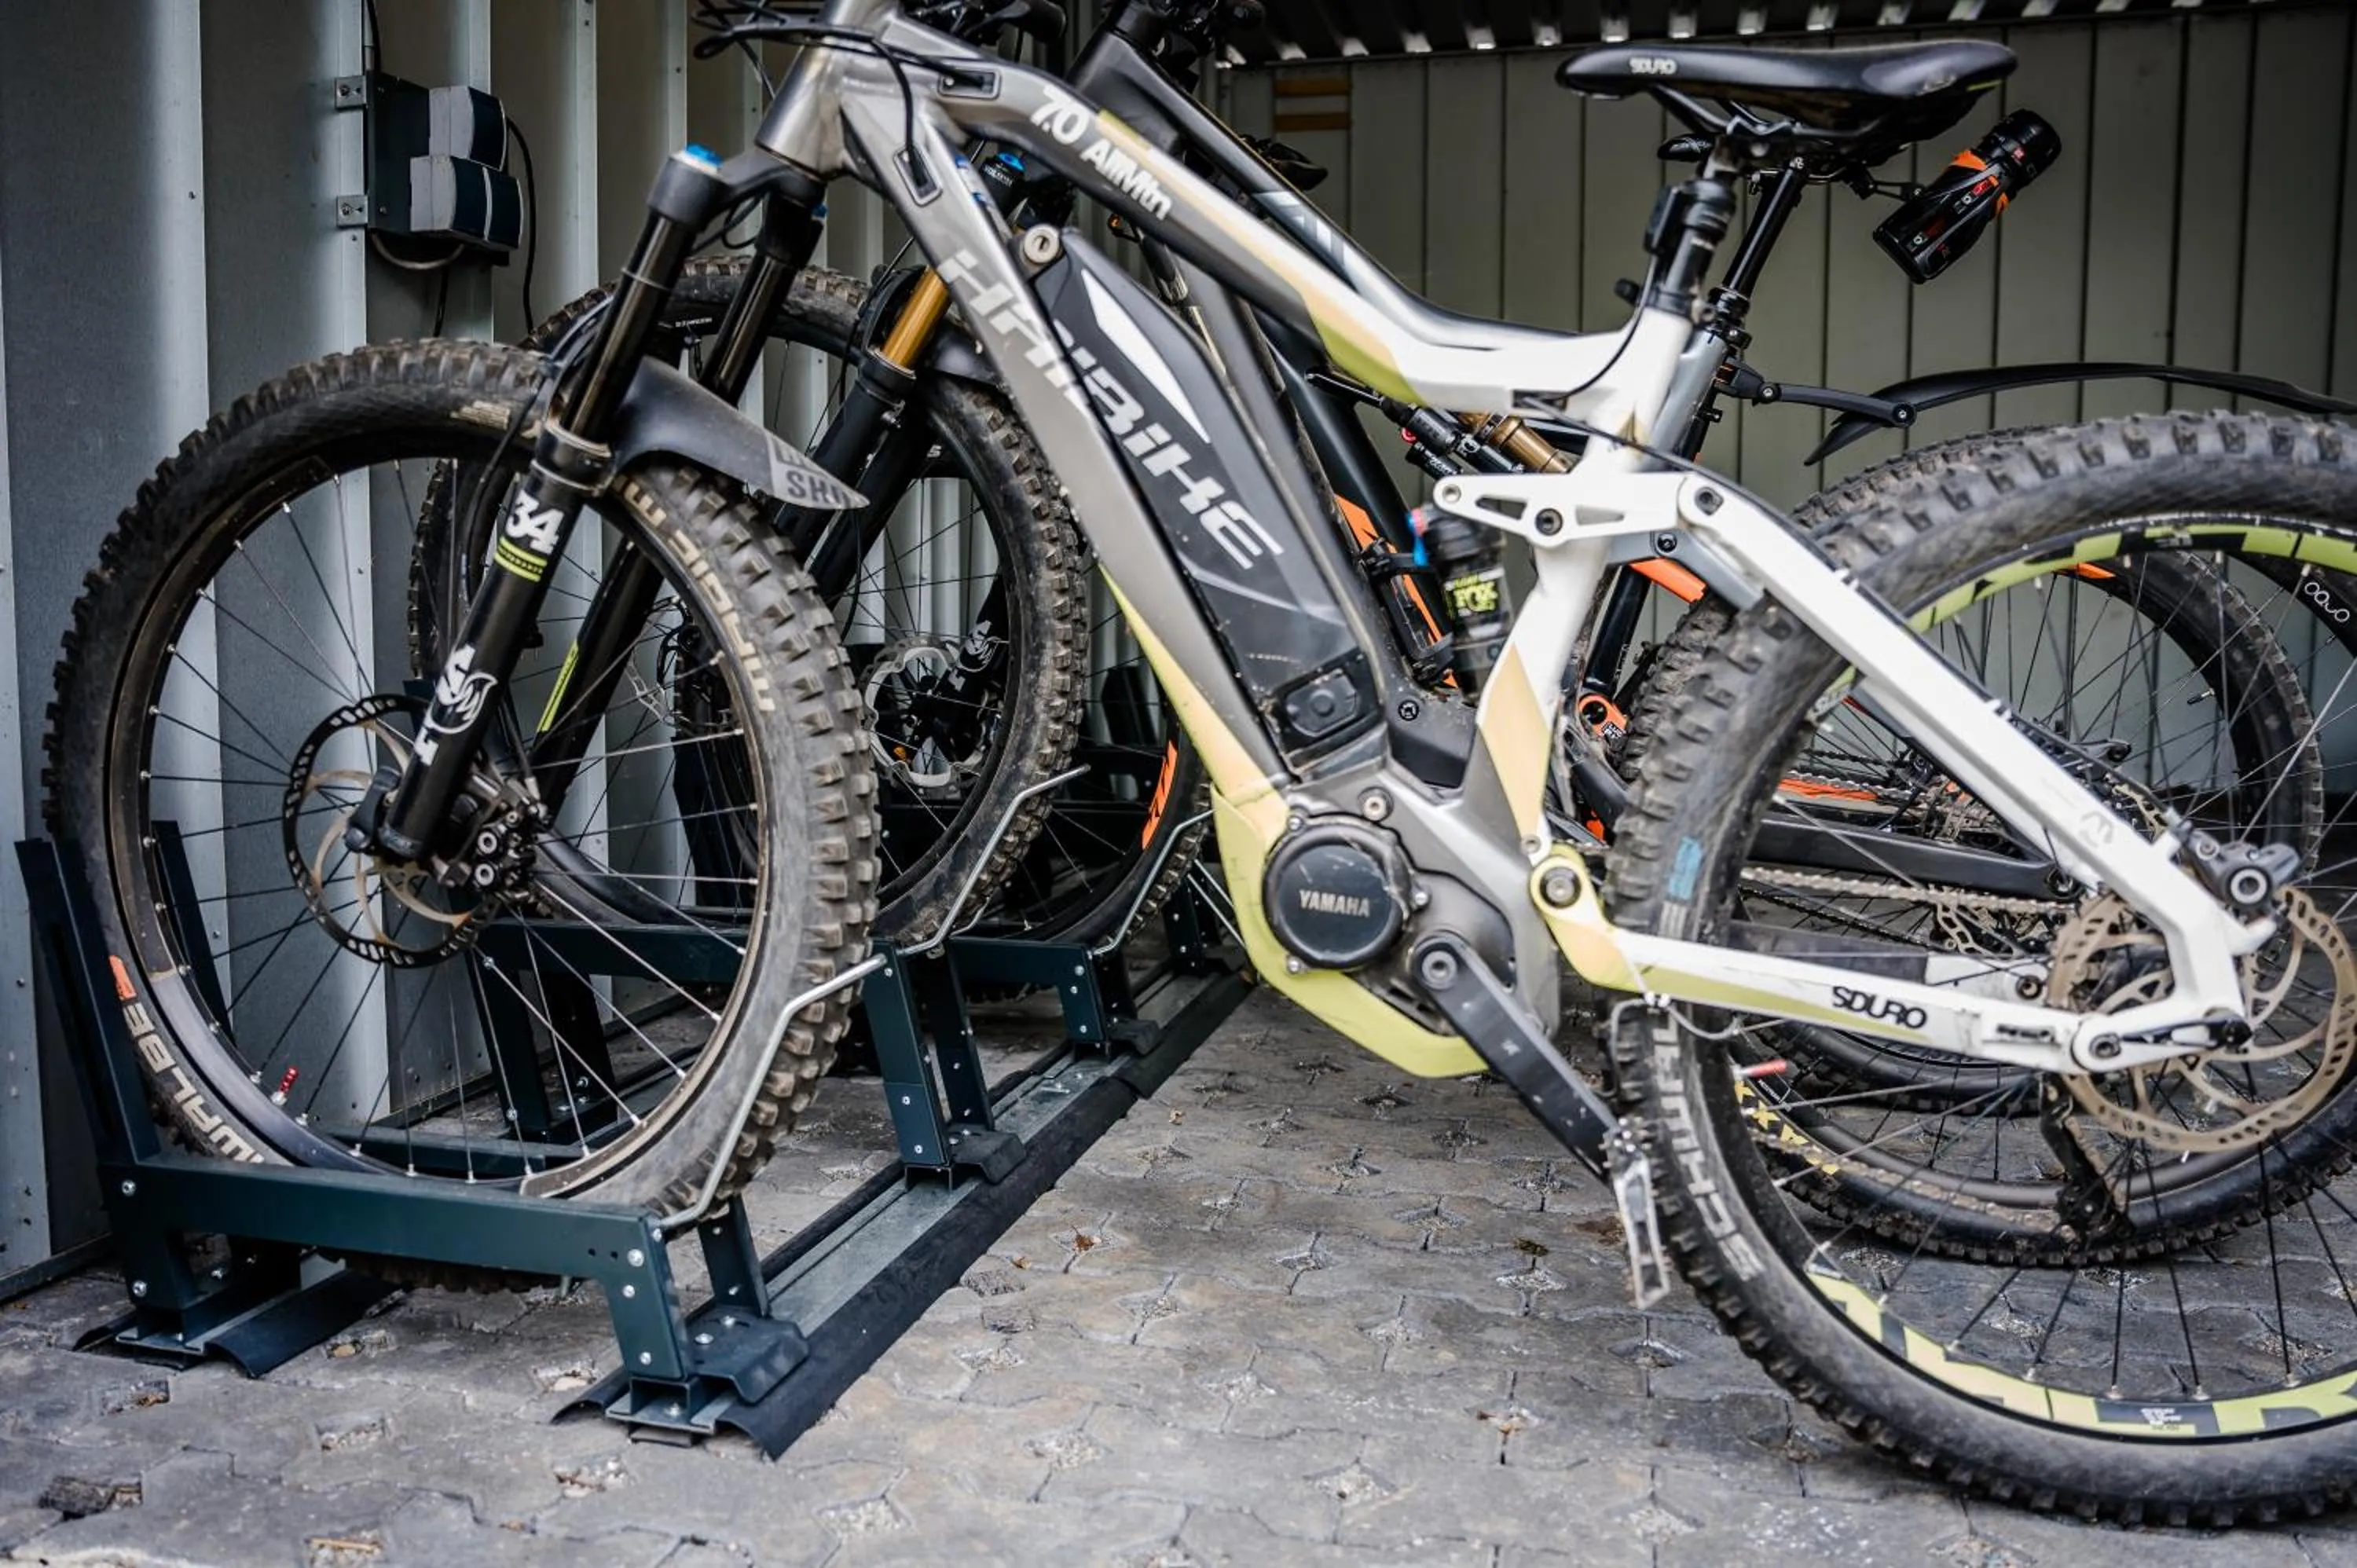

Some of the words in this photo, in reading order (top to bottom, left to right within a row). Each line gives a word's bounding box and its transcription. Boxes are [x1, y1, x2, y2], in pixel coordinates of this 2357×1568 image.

[1028, 84, 1089, 145] 7.0
[505, 489, 564, 554] 34
[1299, 888, 1370, 918] YAMAHA
[1833, 986, 1927, 1029] SDURO
[122, 1002, 265, 1163] WALBE
[1652, 899, 1765, 1280] SCHWALE
